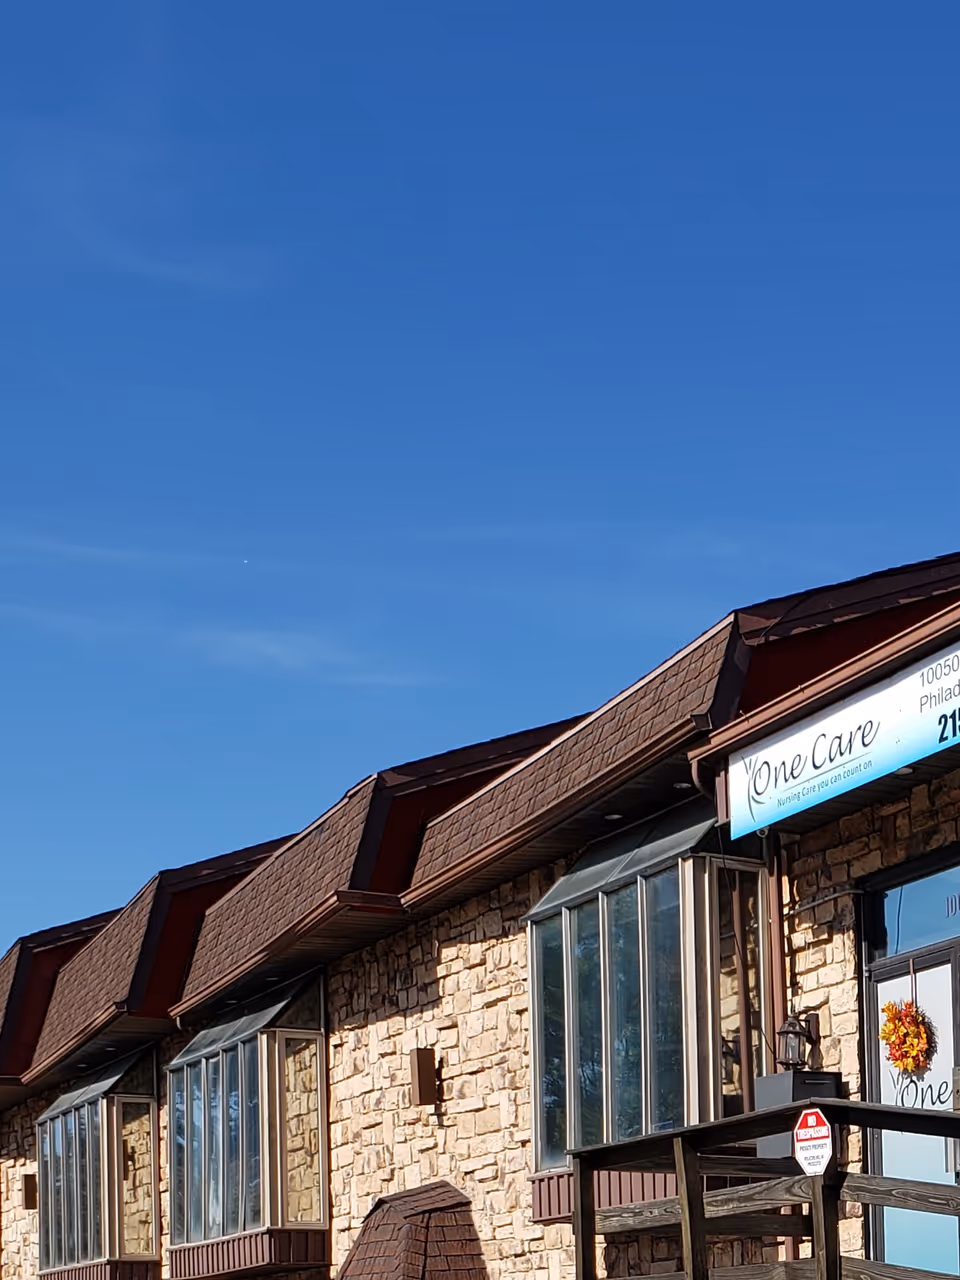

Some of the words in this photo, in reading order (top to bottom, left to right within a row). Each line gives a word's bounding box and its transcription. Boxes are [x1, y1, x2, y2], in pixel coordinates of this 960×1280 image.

[920, 654, 960, 687] 10050
[753, 754, 808, 796] One
[811, 720, 880, 770] Care
[777, 790, 801, 808] Nursing
[801, 784, 816, 798] Care
[817, 777, 829, 792] you
[830, 774, 842, 785] can
[843, 763, 863, 779] count
[863, 760, 873, 770] on
